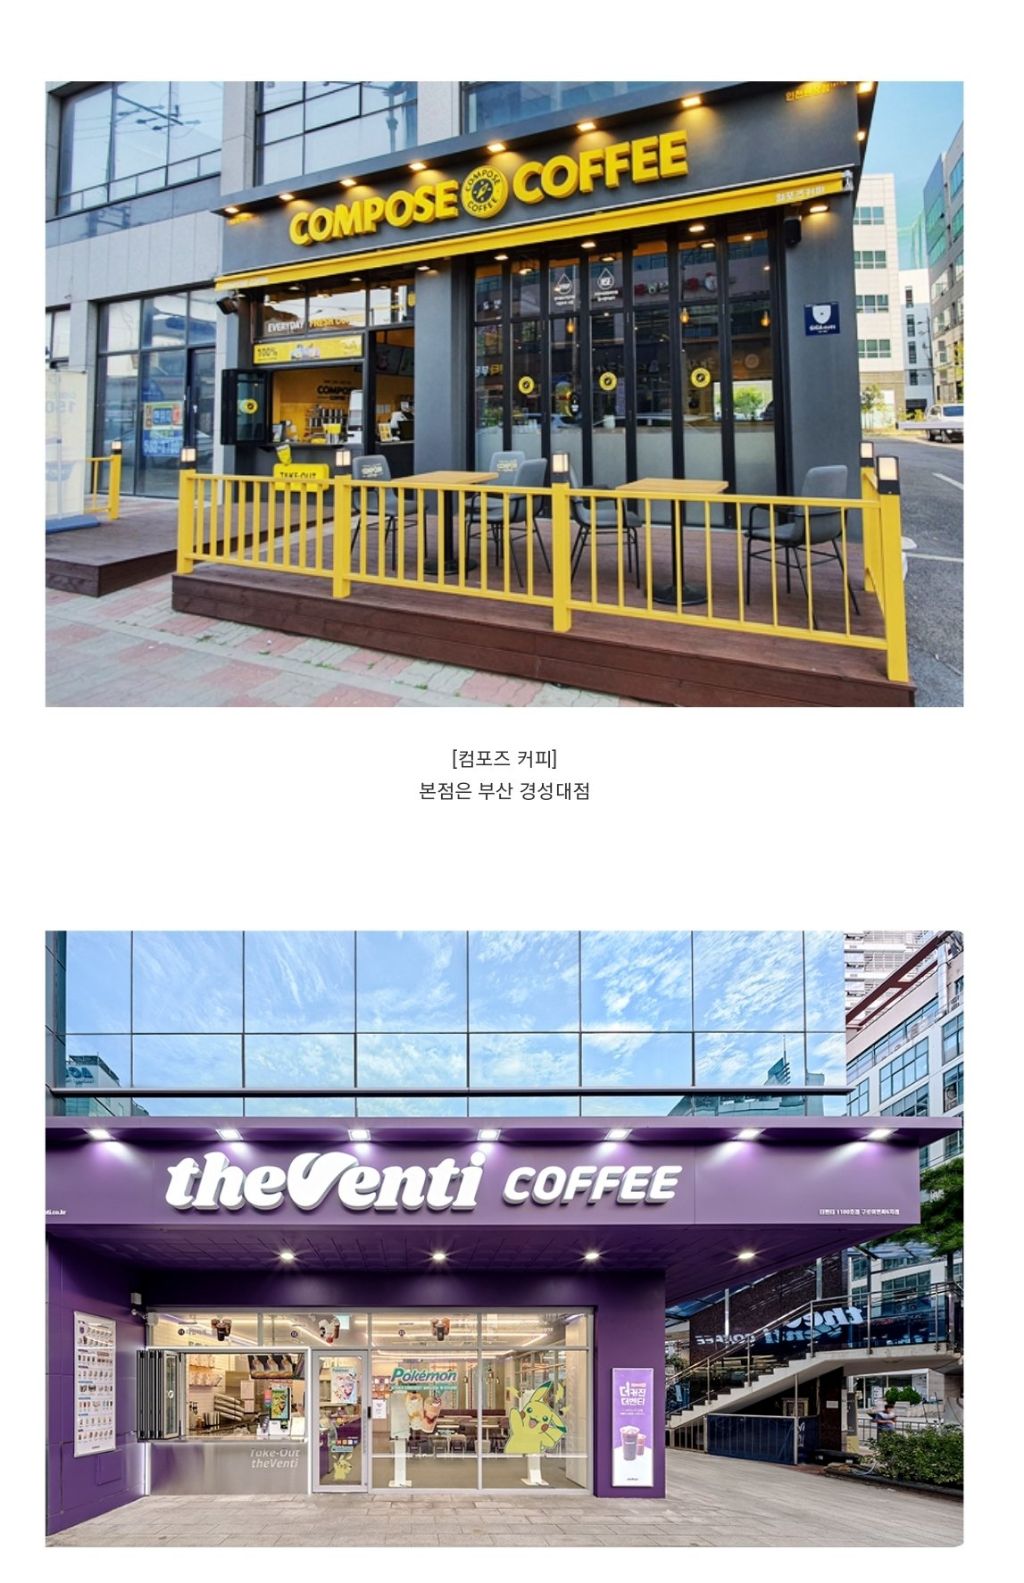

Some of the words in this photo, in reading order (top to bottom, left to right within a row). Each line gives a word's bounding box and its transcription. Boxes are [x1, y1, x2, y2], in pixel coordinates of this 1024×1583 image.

[289, 179, 459, 247] COMPOSE
[513, 129, 688, 204] COFFEE
[465, 167, 501, 192] COMPOSE
[466, 198, 500, 213] COFFEE
[503, 1165, 682, 1206] COFFEE
[390, 1367, 457, 1384] Pokémon
